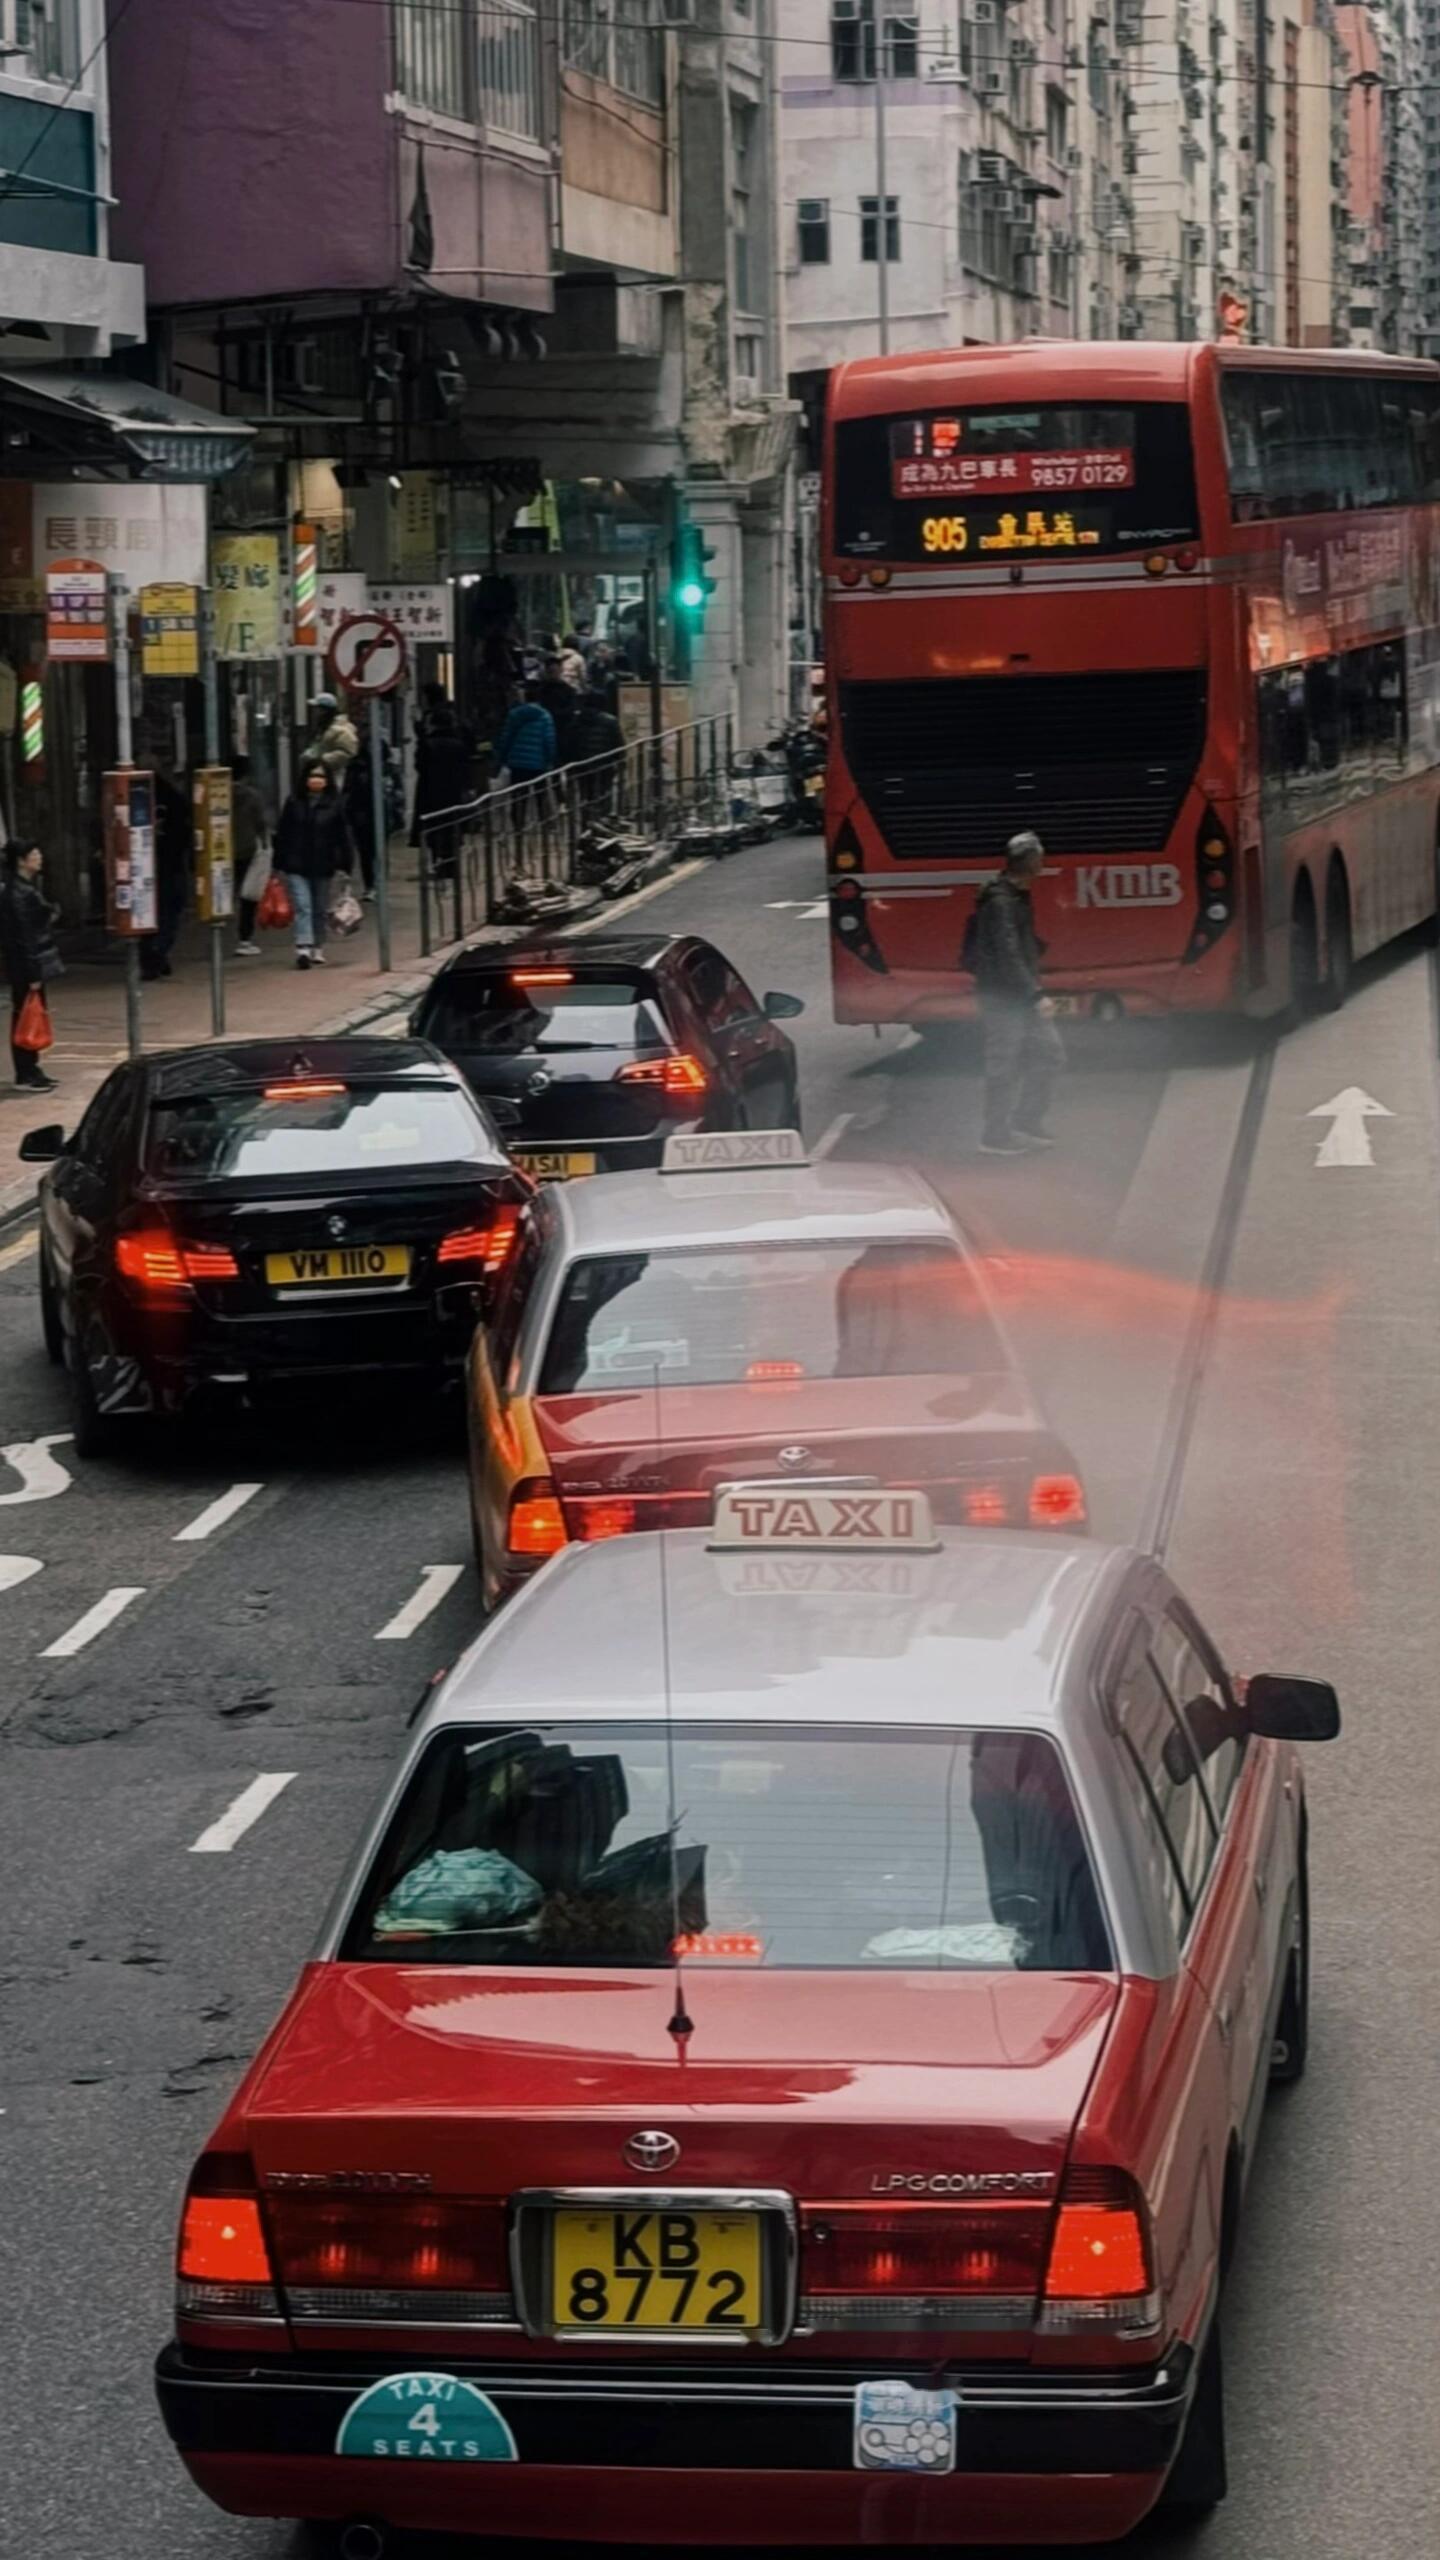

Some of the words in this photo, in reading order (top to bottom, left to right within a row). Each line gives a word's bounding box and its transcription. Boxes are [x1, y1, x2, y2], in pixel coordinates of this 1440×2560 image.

[1031, 467, 1077, 486] 9857
[1081, 464, 1128, 484] 0129
[923, 517, 967, 551] 905
[1075, 864, 1183, 909] KMB
[674, 1134, 793, 1164] TAXI
[290, 1253, 329, 1278] VM
[730, 1499, 914, 1537] TAXI
[614, 2214, 699, 2267] KB
[569, 2268, 746, 2324] 8772
[388, 2378, 456, 2400] TAXI
[408, 2403, 441, 2437] 4
[373, 2439, 479, 2456] SEATS
